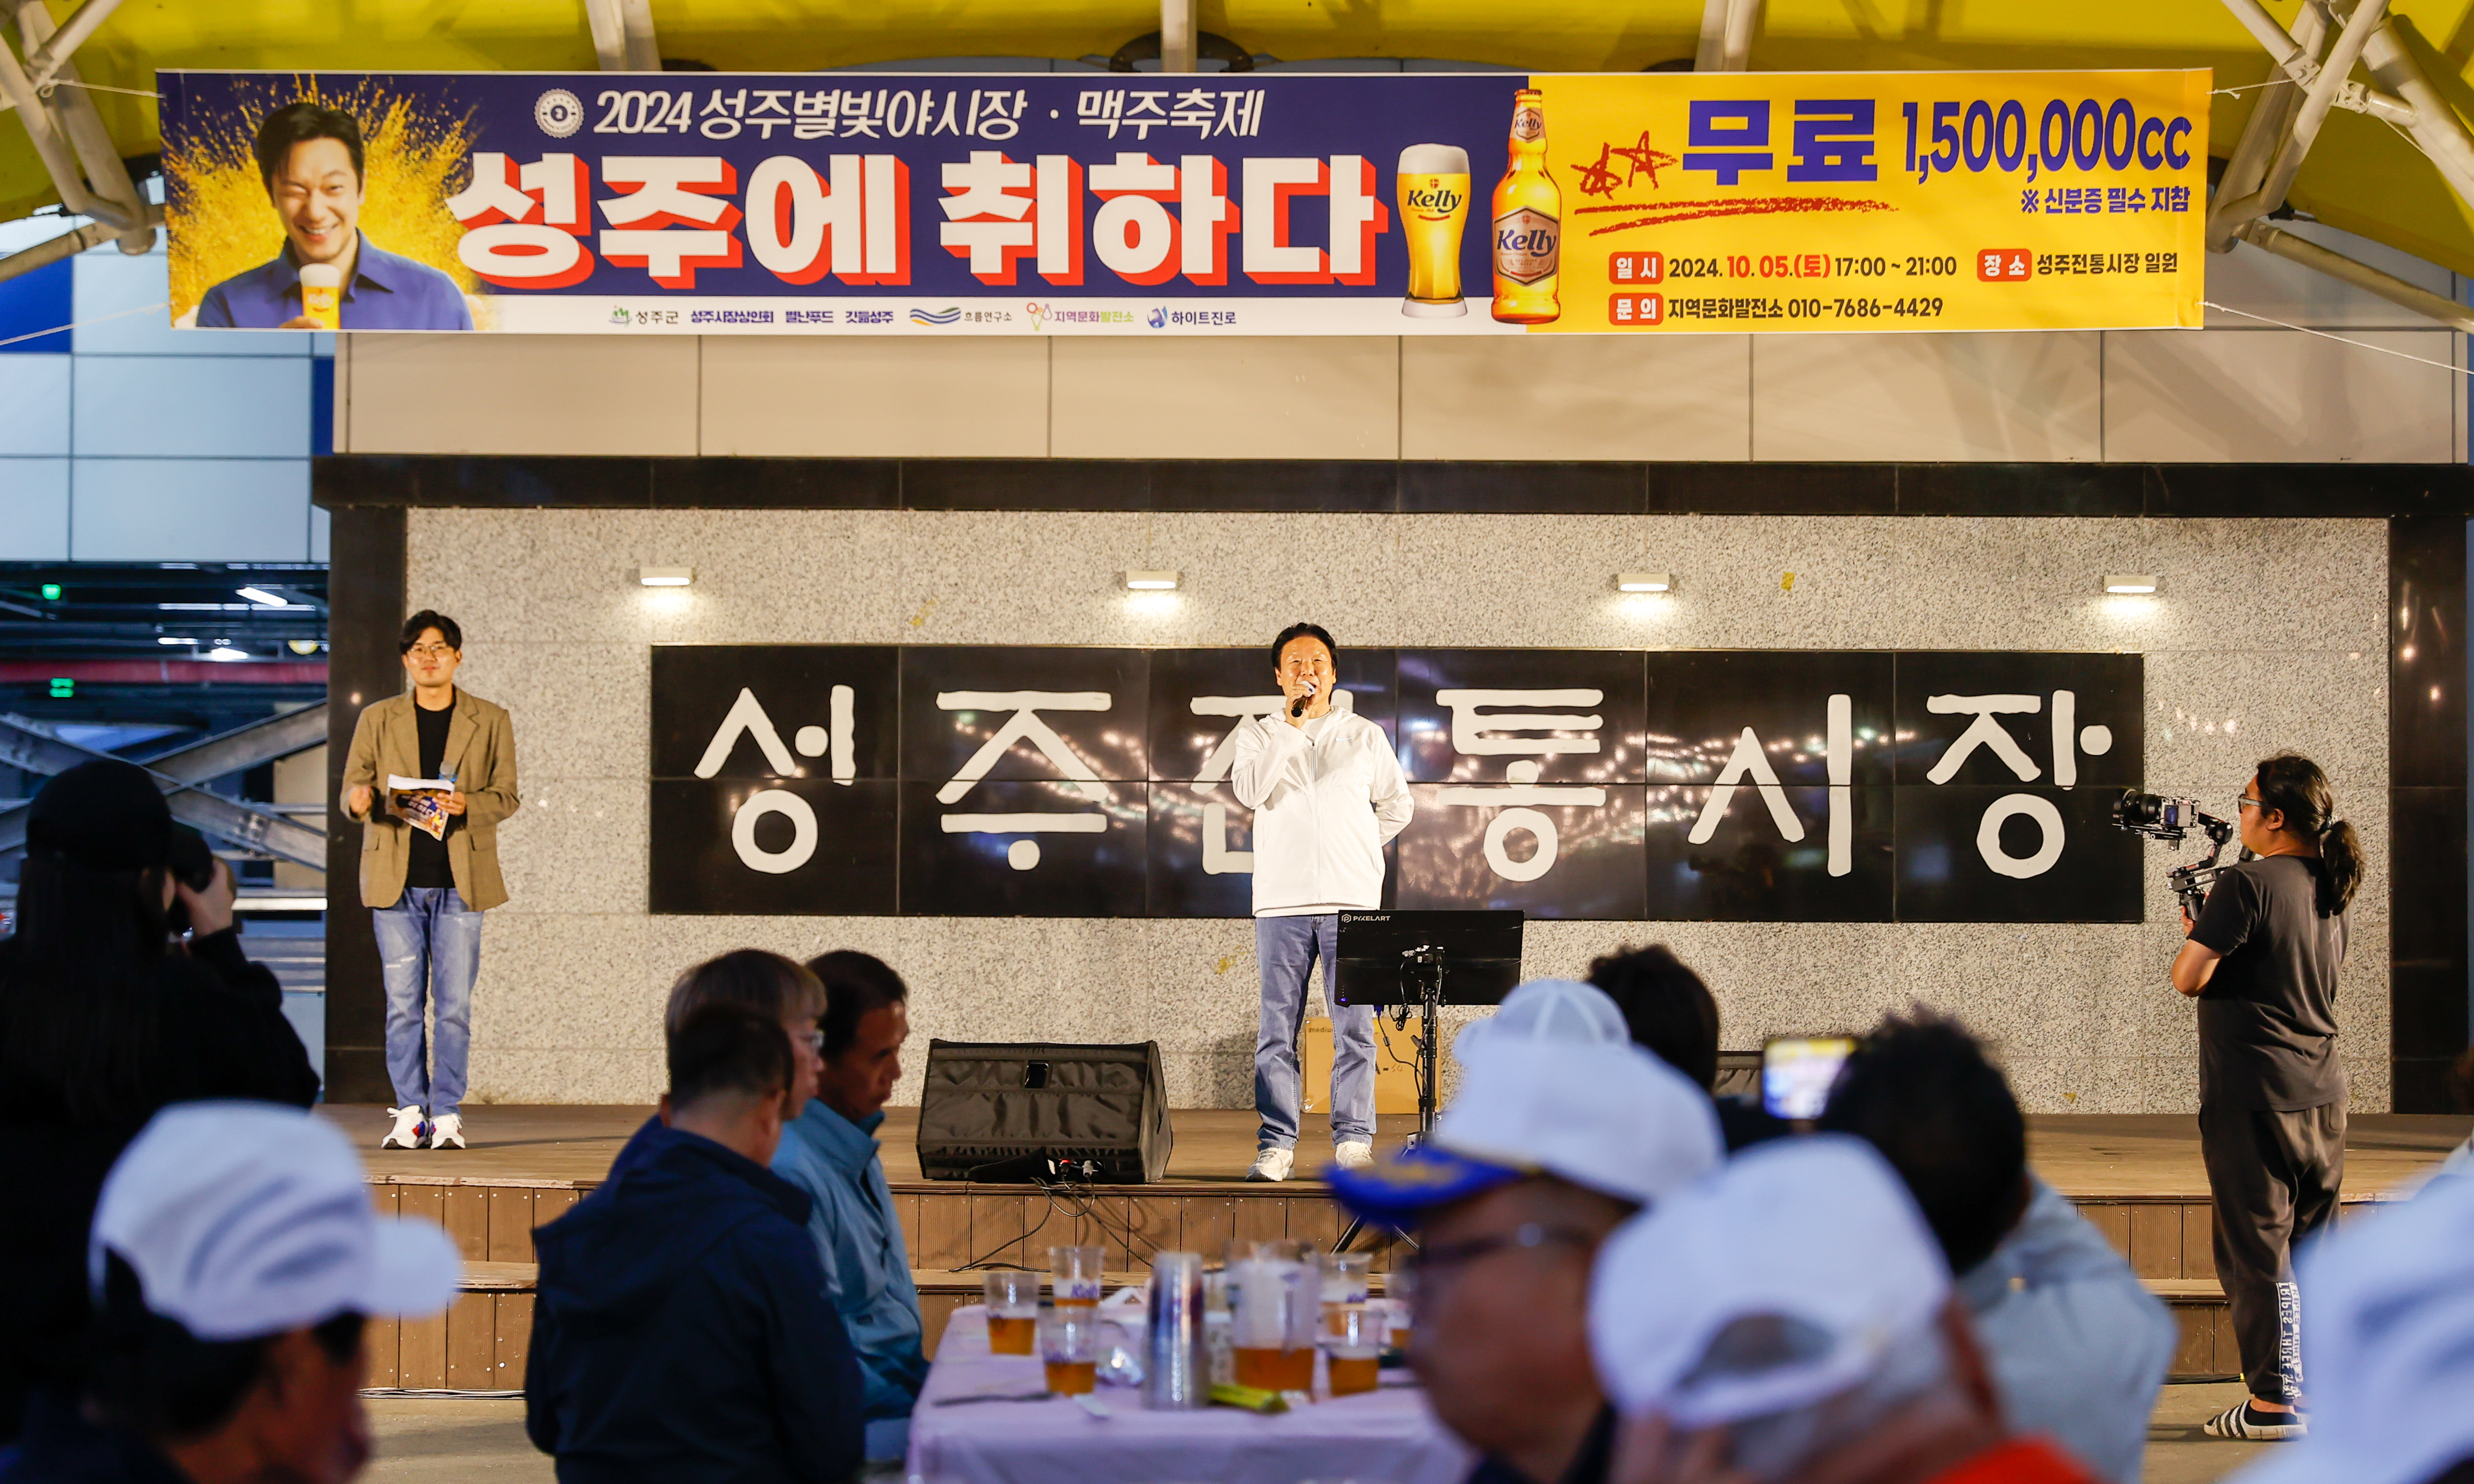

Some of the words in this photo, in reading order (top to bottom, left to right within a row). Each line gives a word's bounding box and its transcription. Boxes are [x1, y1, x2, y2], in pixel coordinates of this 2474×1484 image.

[593, 90, 694, 134] 2024
[1076, 88, 1265, 140] 맥주축제
[1515, 118, 1541, 130] Kelly
[1683, 99, 1878, 186] 무료
[1902, 98, 2193, 184] 1,500,000cc
[1407, 190, 1461, 213] Kelly
[2044, 188, 2102, 214] 신분증
[2107, 187, 2146, 214] 필수
[2151, 186, 2191, 213] 지참
[445, 151, 911, 289] 성주에
[938, 150, 1389, 286] 취하다
[1497, 229, 1556, 257] Kelly
[1669, 258, 1723, 278] 2024.
[1727, 256, 1755, 278] 10.
[1835, 257, 1886, 277] 17:00
[1905, 256, 1957, 276] 21:00
[2037, 253, 2139, 275] 성주전통시장
[2145, 252, 2177, 274] 일원
[636, 311, 678, 324] 성주군
[691, 310, 774, 323] 성주시장상인회
[1171, 311, 1236, 325] 하이트진로
[1669, 298, 1783, 319] 지역문화발전소
[1788, 297, 1944, 318] 010-7686-4429
